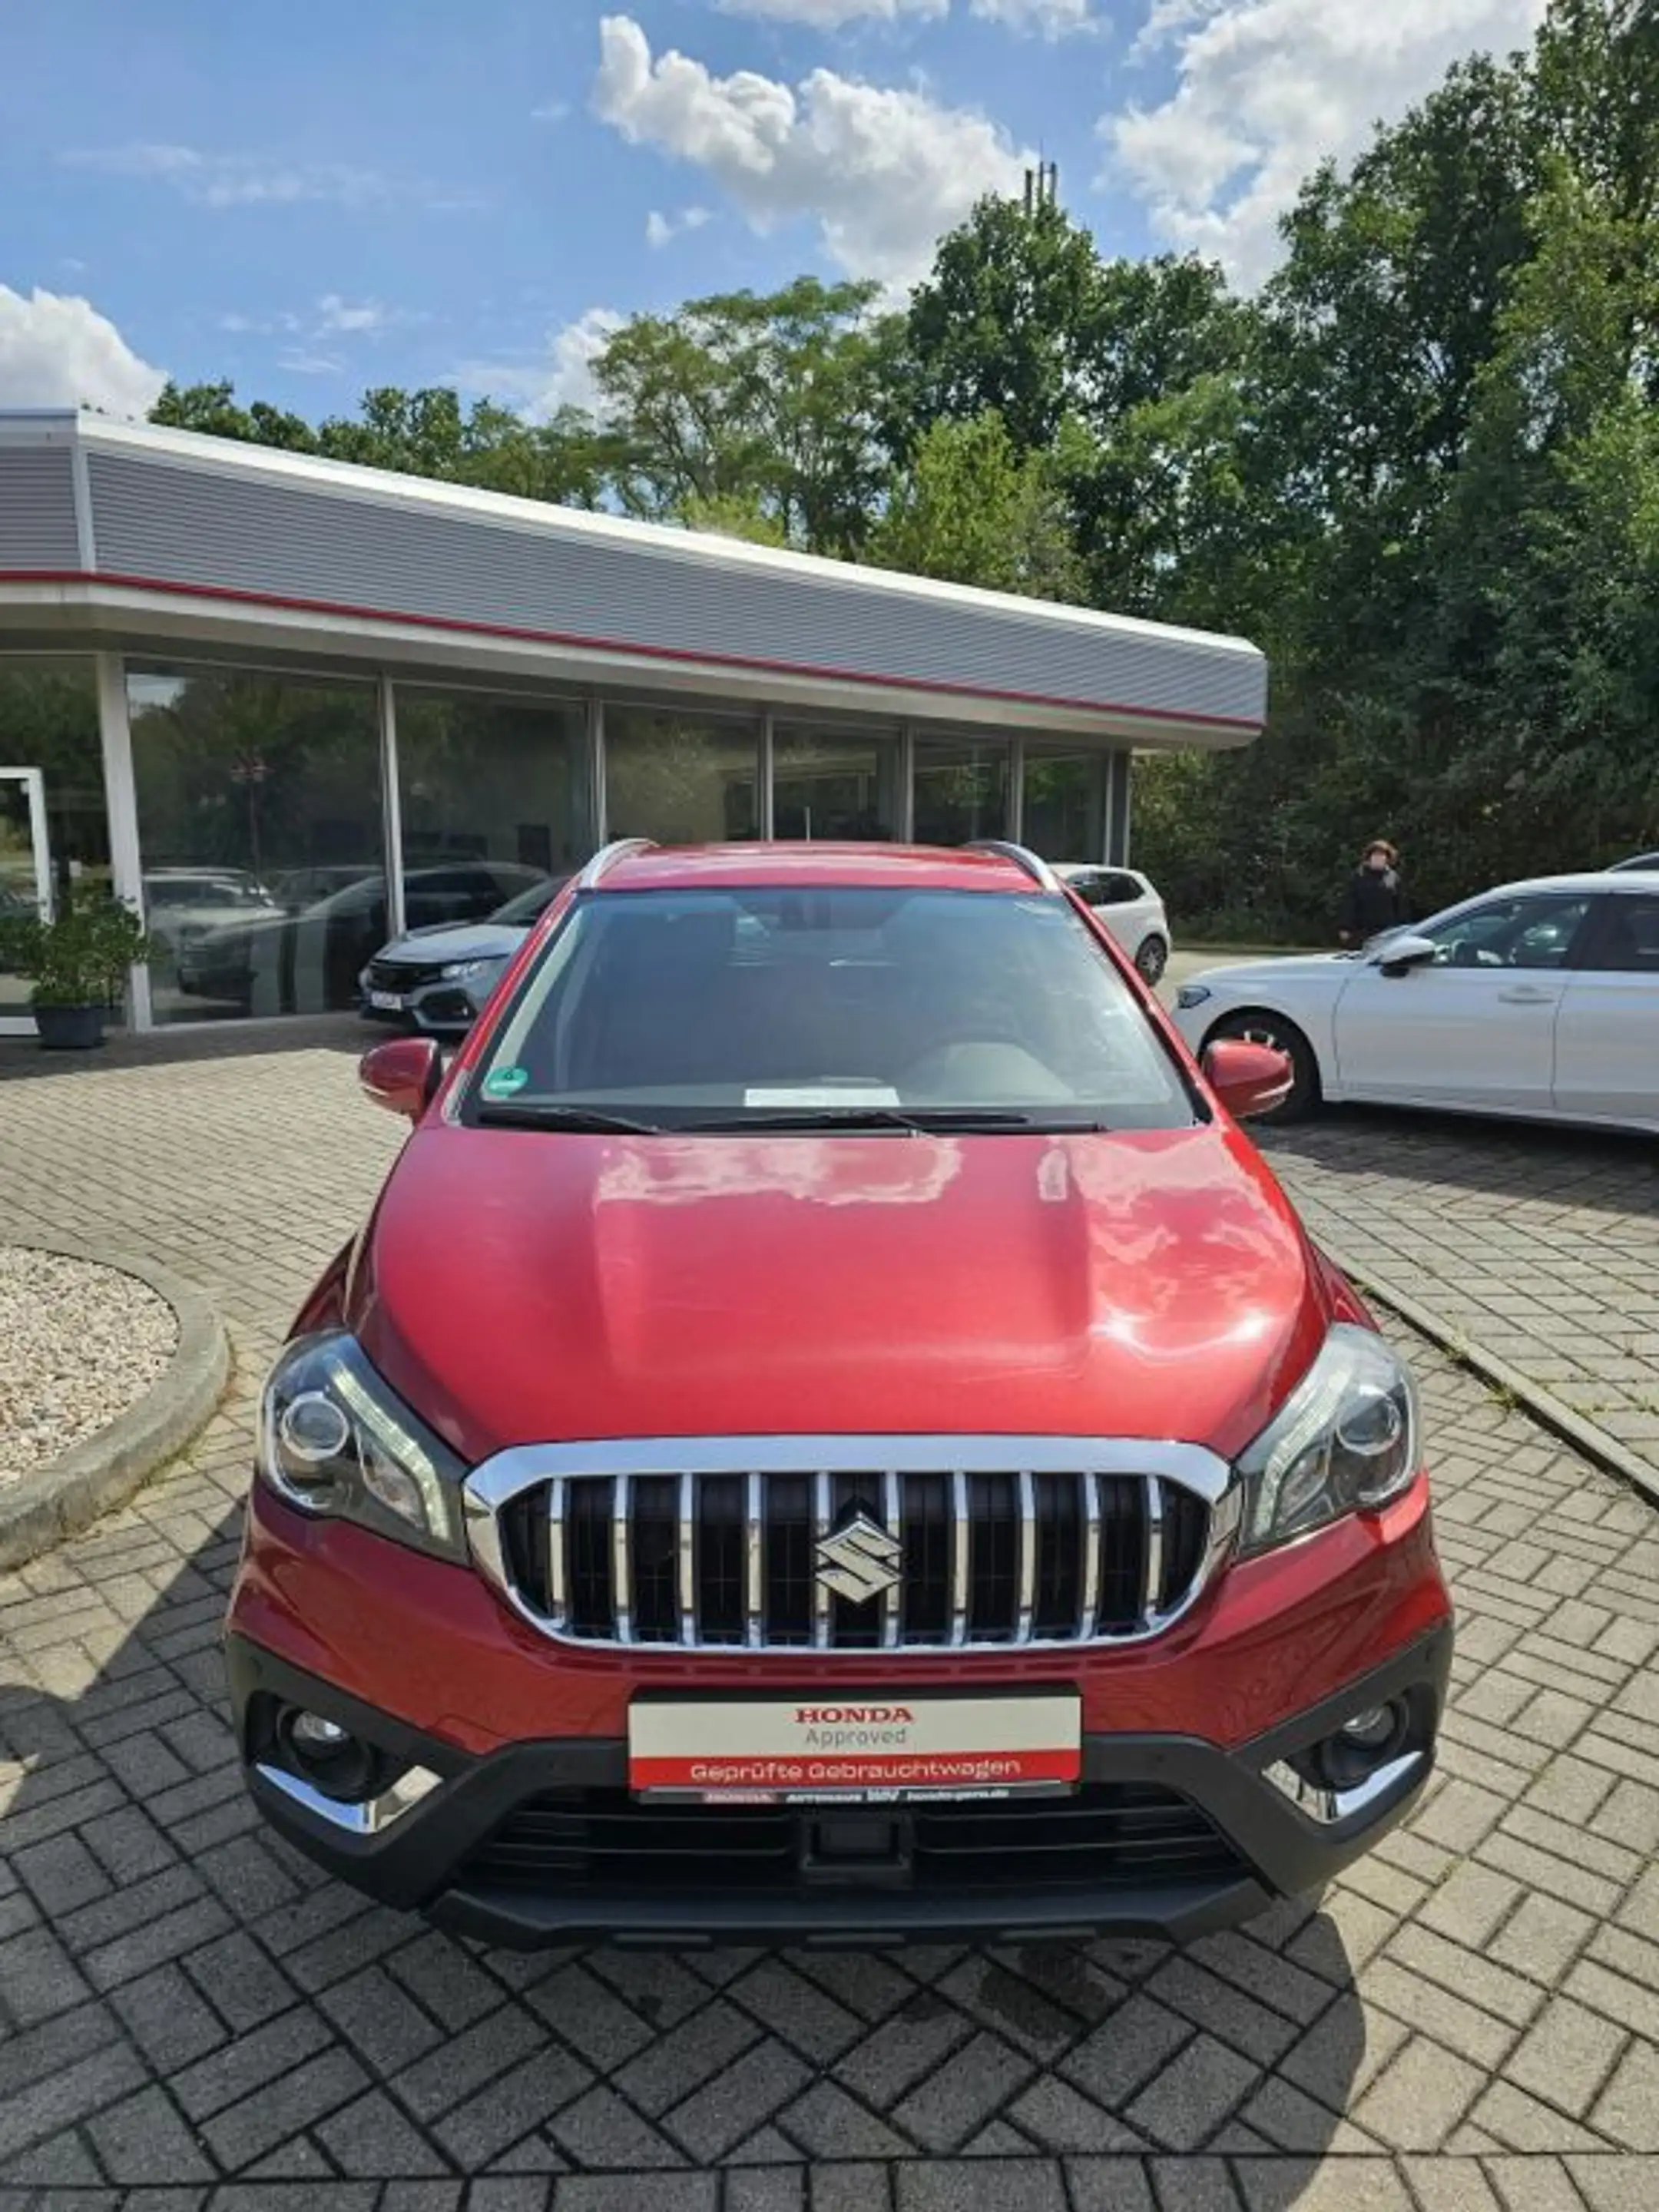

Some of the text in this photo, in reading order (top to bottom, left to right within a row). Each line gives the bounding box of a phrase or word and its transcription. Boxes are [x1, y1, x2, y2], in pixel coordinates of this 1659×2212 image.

[795, 1707, 913, 1724] HONDA
[806, 1728, 906, 1747] Approved
[690, 1757, 1021, 1783] Geprüfte Gebrauchtwagen
